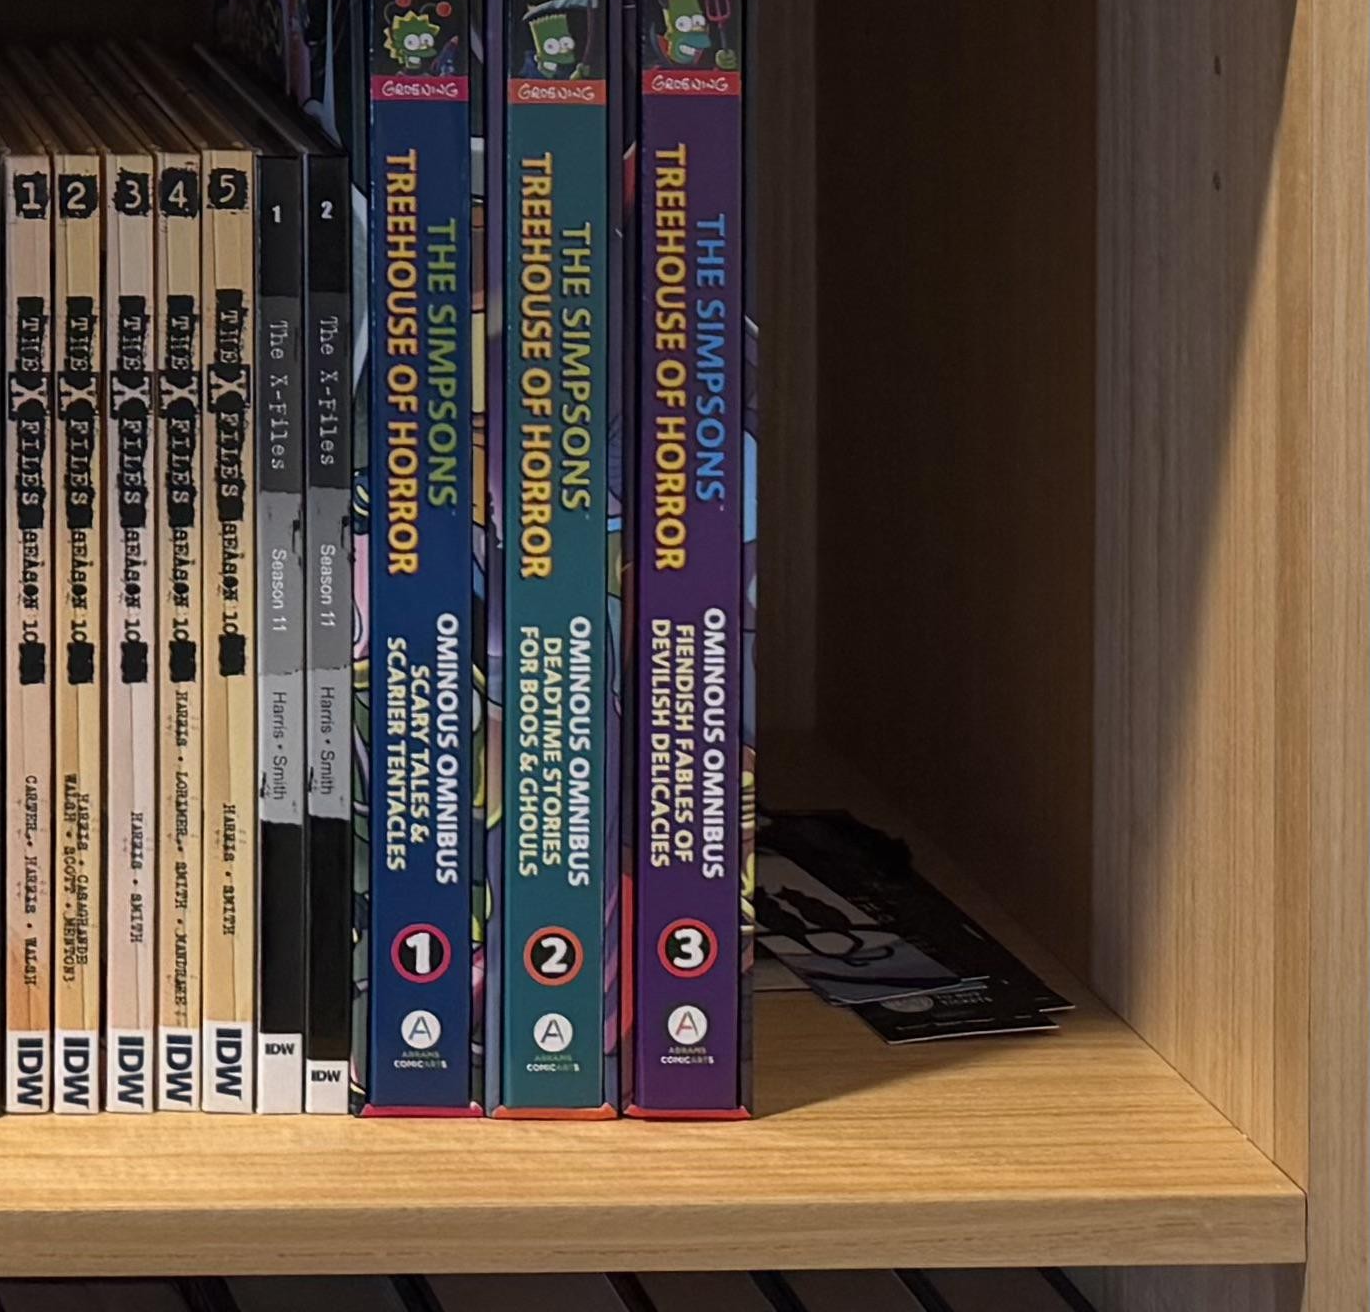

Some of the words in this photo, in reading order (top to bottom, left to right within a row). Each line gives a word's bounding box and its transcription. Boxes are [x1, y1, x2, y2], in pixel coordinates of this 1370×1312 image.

[654, 145, 686, 352] TREEHOUSE
[694, 214, 724, 285] THE
[655, 361, 687, 406] OF
[695, 298, 725, 503] SIMPSONS
[655, 416, 688, 570] HORROR
[673, 930, 703, 967] 3
